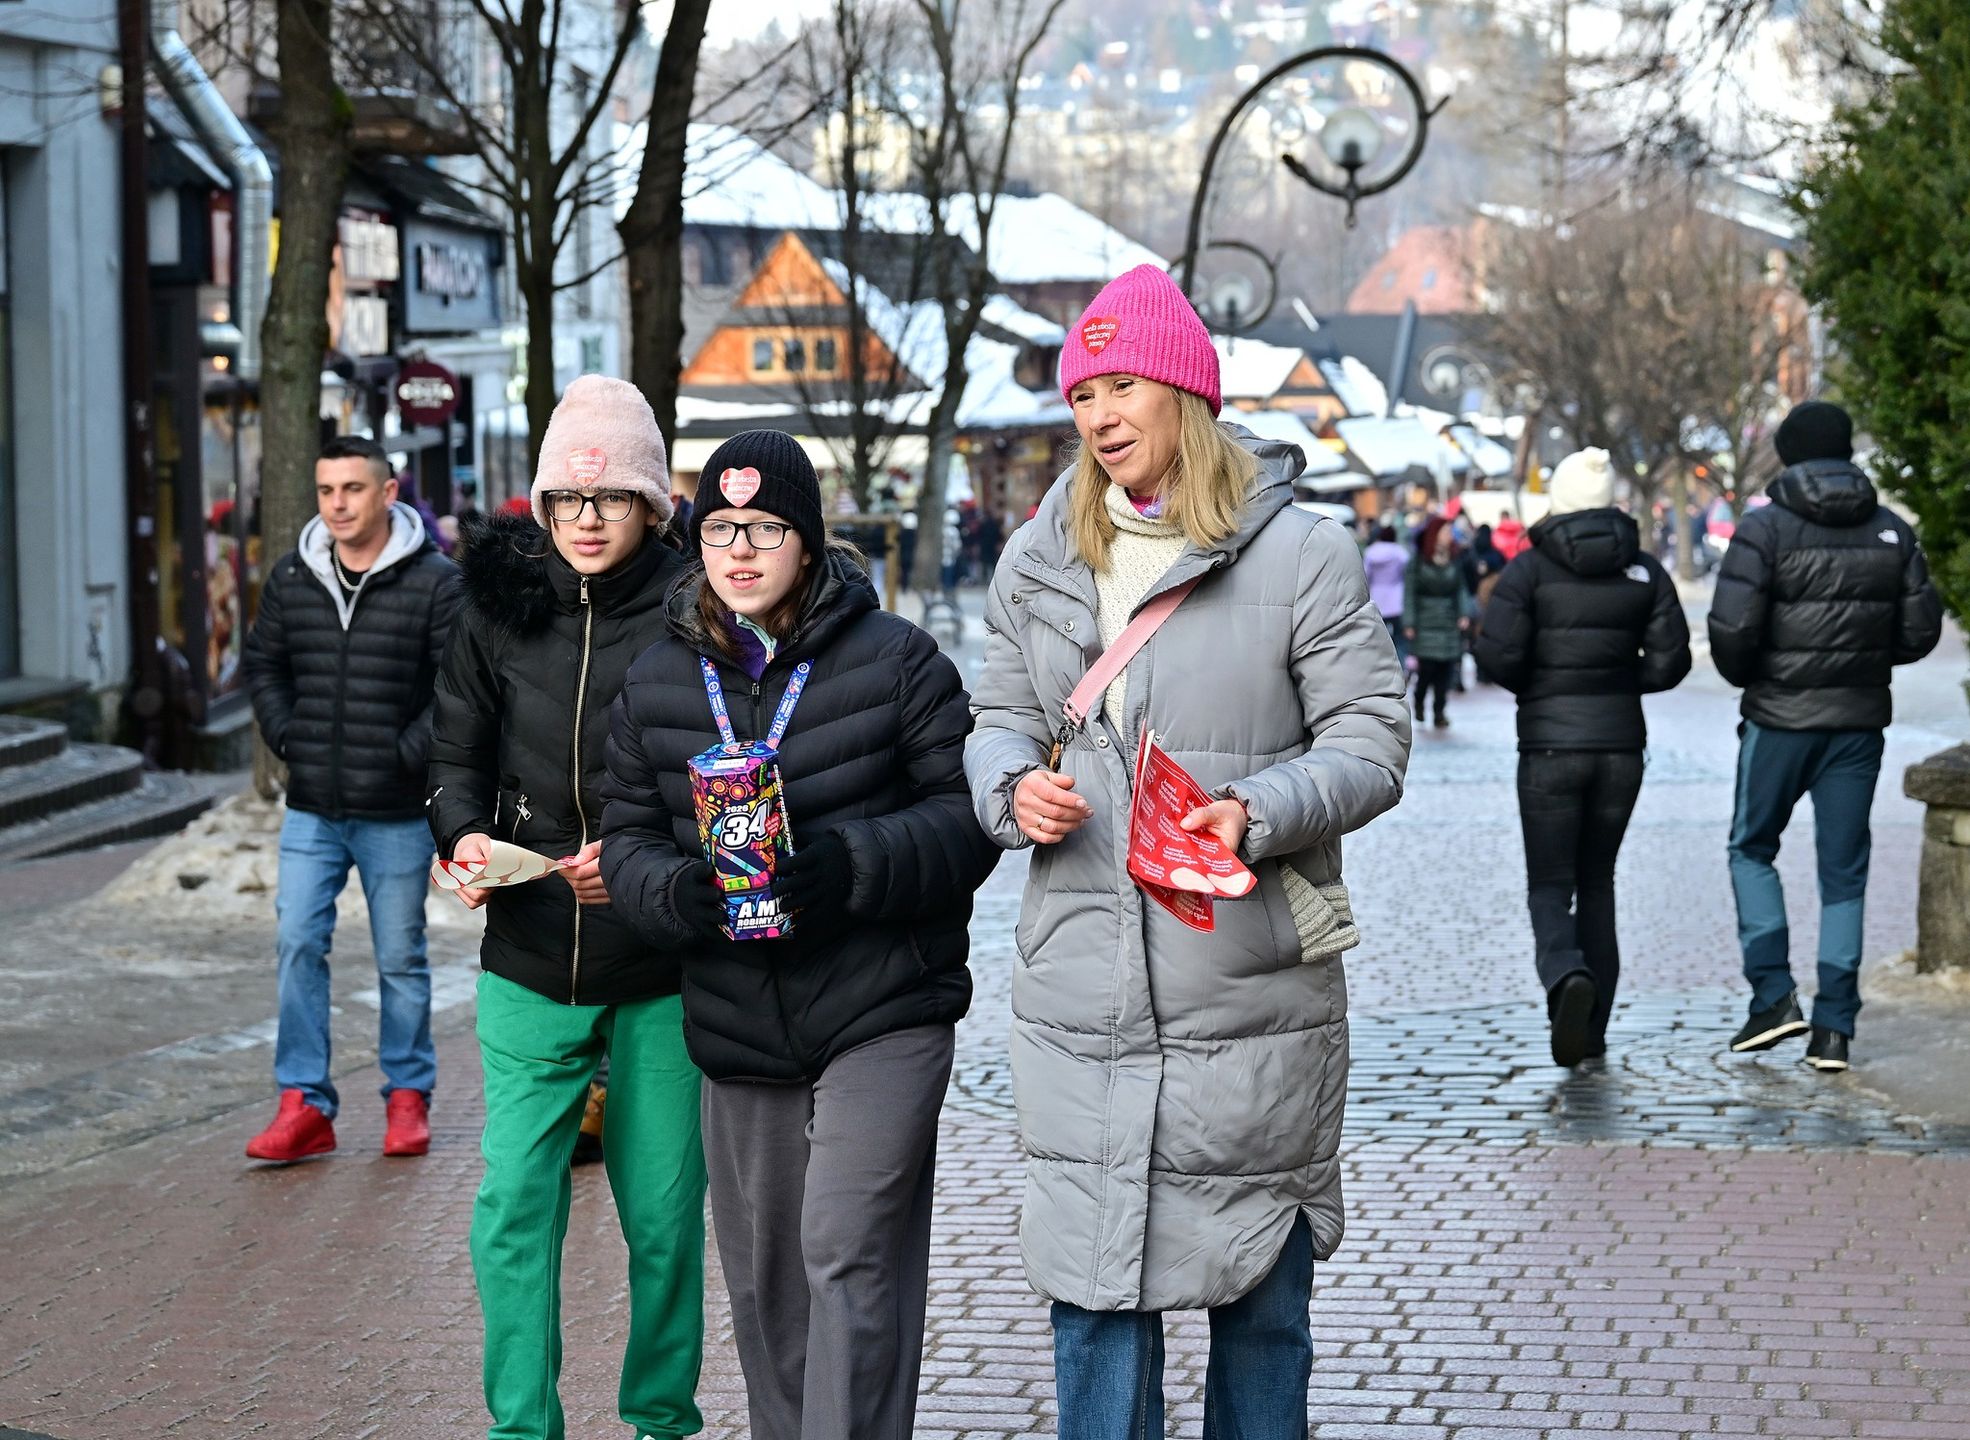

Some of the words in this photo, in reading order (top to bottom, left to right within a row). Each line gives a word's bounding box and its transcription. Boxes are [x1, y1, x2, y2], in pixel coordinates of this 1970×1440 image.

[772, 718, 786, 736] 112
[724, 804, 749, 814] 2026
[720, 799, 769, 850] 34
[738, 902, 754, 919] A
[757, 896, 783, 918] MY
[737, 916, 772, 927] ROBIMY
